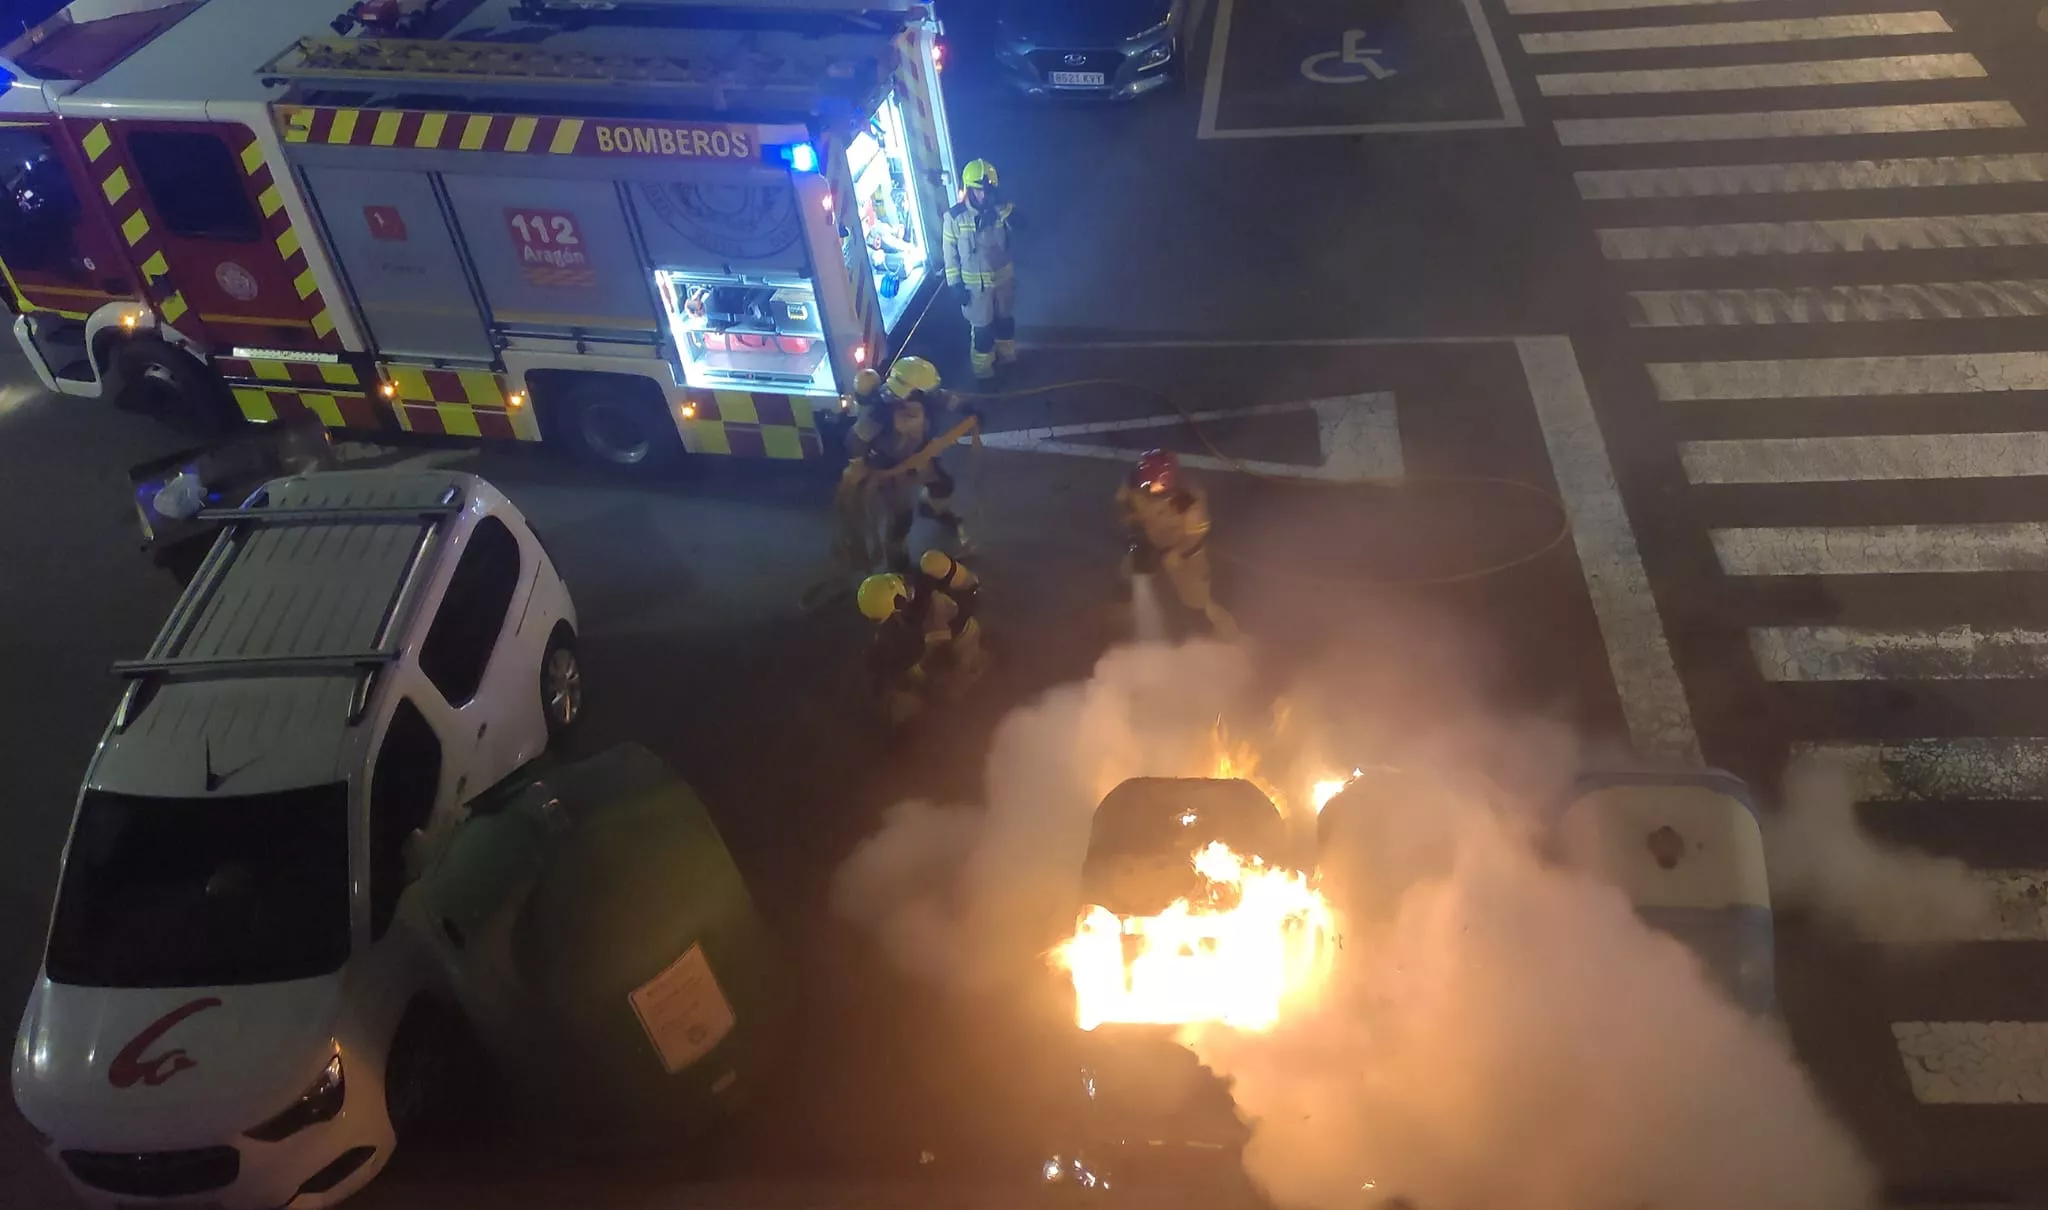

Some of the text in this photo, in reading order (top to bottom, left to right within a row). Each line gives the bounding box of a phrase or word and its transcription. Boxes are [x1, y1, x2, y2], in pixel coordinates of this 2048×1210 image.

[595, 125, 750, 158] BOMBEROS
[511, 214, 579, 244] 112
[524, 244, 585, 268] Aragón
